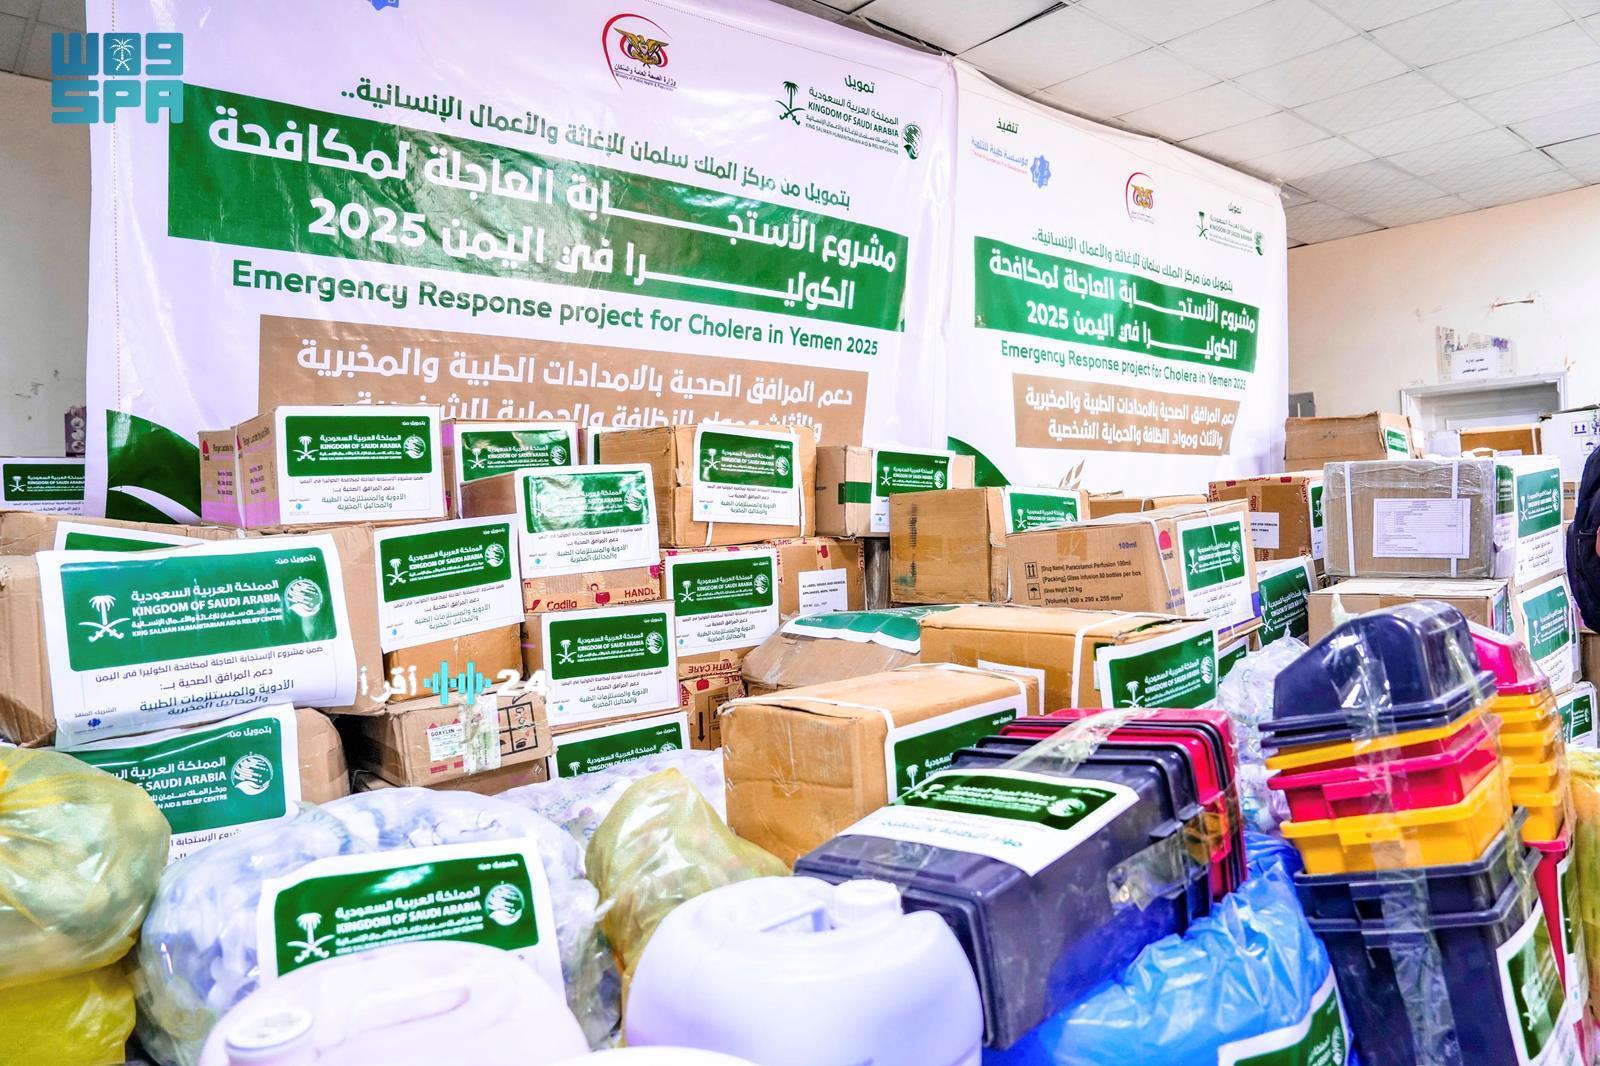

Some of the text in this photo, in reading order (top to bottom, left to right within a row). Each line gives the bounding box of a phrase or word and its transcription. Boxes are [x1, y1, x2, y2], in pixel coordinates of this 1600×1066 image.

[845, 75, 875, 94] تمويل
[809, 87, 898, 125] المملكة العربية السعودية
[470, 104, 558, 144] والأعمال
[808, 102, 899, 137] KINGDOM OF SAUDI ARABIA
[996, 117, 1019, 133] تنفيذ
[208, 105, 411, 180] لمكافحة
[565, 123, 625, 157] للإغاثة
[631, 141, 689, 169] سلمان
[424, 145, 553, 205] العاجلة
[694, 157, 737, 180] الملك
[741, 166, 776, 191] مركز
[780, 178, 801, 197] من
[805, 183, 850, 211] بتمويل
[308, 197, 426, 248] 2025
[442, 216, 546, 269] اليمن
[822, 233, 896, 273] مشروع
[1080, 239, 1112, 262] والأعمال
[555, 236, 613, 274] في
[1115, 249, 1140, 266] للإغاثة
[1142, 257, 1160, 274] سلمان
[989, 248, 1059, 289] لمكافحة
[1162, 264, 1183, 279] الملك
[1185, 271, 1200, 284] مركز
[1202, 275, 1211, 286] من
[1063, 267, 1114, 300] العاجلة
[1213, 277, 1233, 292] بتمويل
[233, 259, 877, 356] Emergency Response project for Cholera in Yemen 2025
[1026, 300, 1069, 330] 2025
[1073, 310, 1114, 341] اليمن
[1118, 320, 1139, 342] في
[1221, 308, 1255, 333] مشروع
[297, 338, 852, 408] دعم المرافق الصحية بالامدادات الطبية والمخبرية
[1001, 340, 1246, 390] Emergency Response project for Cholera in Yemen 2025
[1026, 386, 1081, 414] والمخبرية
[1083, 392, 1114, 415] الطبية
[1160, 402, 1189, 422] الصحية
[1191, 406, 1220, 425] المرافق
[1221, 413, 1235, 426] دعم
[1048, 419, 1223, 450] والأثاث ومواد النظافة والحماية الشخصية
[409, 544, 483, 562] المملكة العربية السعودية
[1118, 541, 1137, 550] 100ml
[409, 561, 436, 570] KINGDOM
[446, 556, 463, 565] SAUDI
[464, 553, 483, 561] ARABIA
[131, 579, 279, 603] المملكة العربية السعودية
[132, 593, 280, 617] KINGDOM OF SAUDI ARABIA
[547, 600, 577, 611] Cadila
[96, 645, 323, 683] ضمن مشروع الإستجابة العاجلة لمكافحة الكوليرا في اليمن
[688, 665, 710, 673] CARE
[179, 668, 273, 689] دعم المرافق الصحية
[140, 678, 294, 712] الأدوية والمستلزمات الطبية
[167, 695, 268, 716] والمحاليل المخبرية
[244, 726, 272, 736] بتمويل
[131, 756, 226, 779] المملكة العربية
[146, 771, 226, 790] SAUDI ARABIA
[159, 786, 227, 801] مركز الملك سلمان
[177, 833, 216, 846] الإستجابة
[335, 886, 480, 920] المملكة العربية السعودية
[336, 901, 481, 934] KINGDOM OF SAUDI ARABIA
